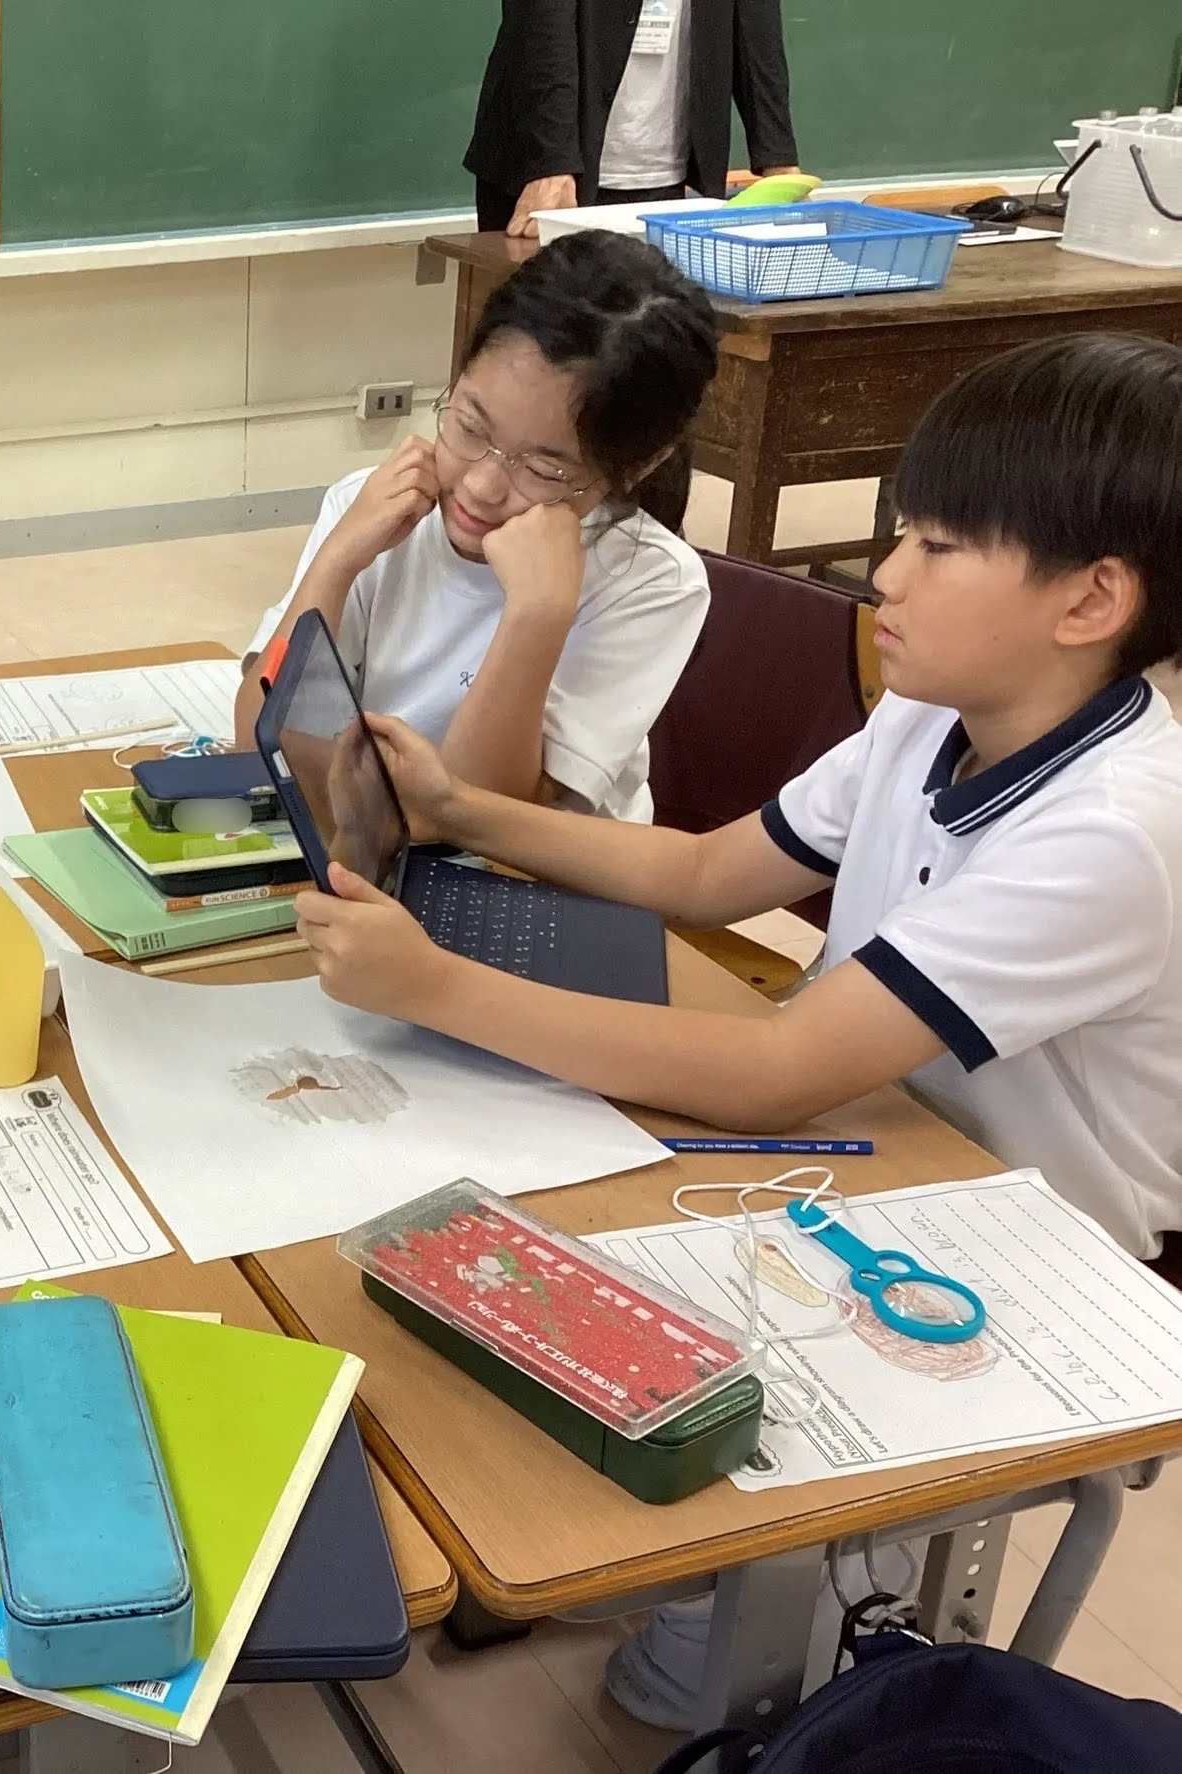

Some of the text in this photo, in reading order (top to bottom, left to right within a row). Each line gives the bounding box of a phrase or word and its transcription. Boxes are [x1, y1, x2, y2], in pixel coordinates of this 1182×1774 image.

[219, 890, 257, 901] SCIENCE
[57, 1133, 70, 1145] does
[81, 1172, 99, 1185] go?
[954, 1256, 968, 1266] is
[779, 1336, 799, 1355] what
[796, 1354, 825, 1384] showing
[1015, 1356, 1031, 1369] the
[1027, 1368, 1044, 1381] for
[821, 1382, 851, 1410] diagram
[801, 1396, 862, 1457] (Your Predictn)
[853, 1418, 872, 1433] draw
[805, 1416, 845, 1462] Hypothesis
[867, 1435, 888, 1453] Let's
